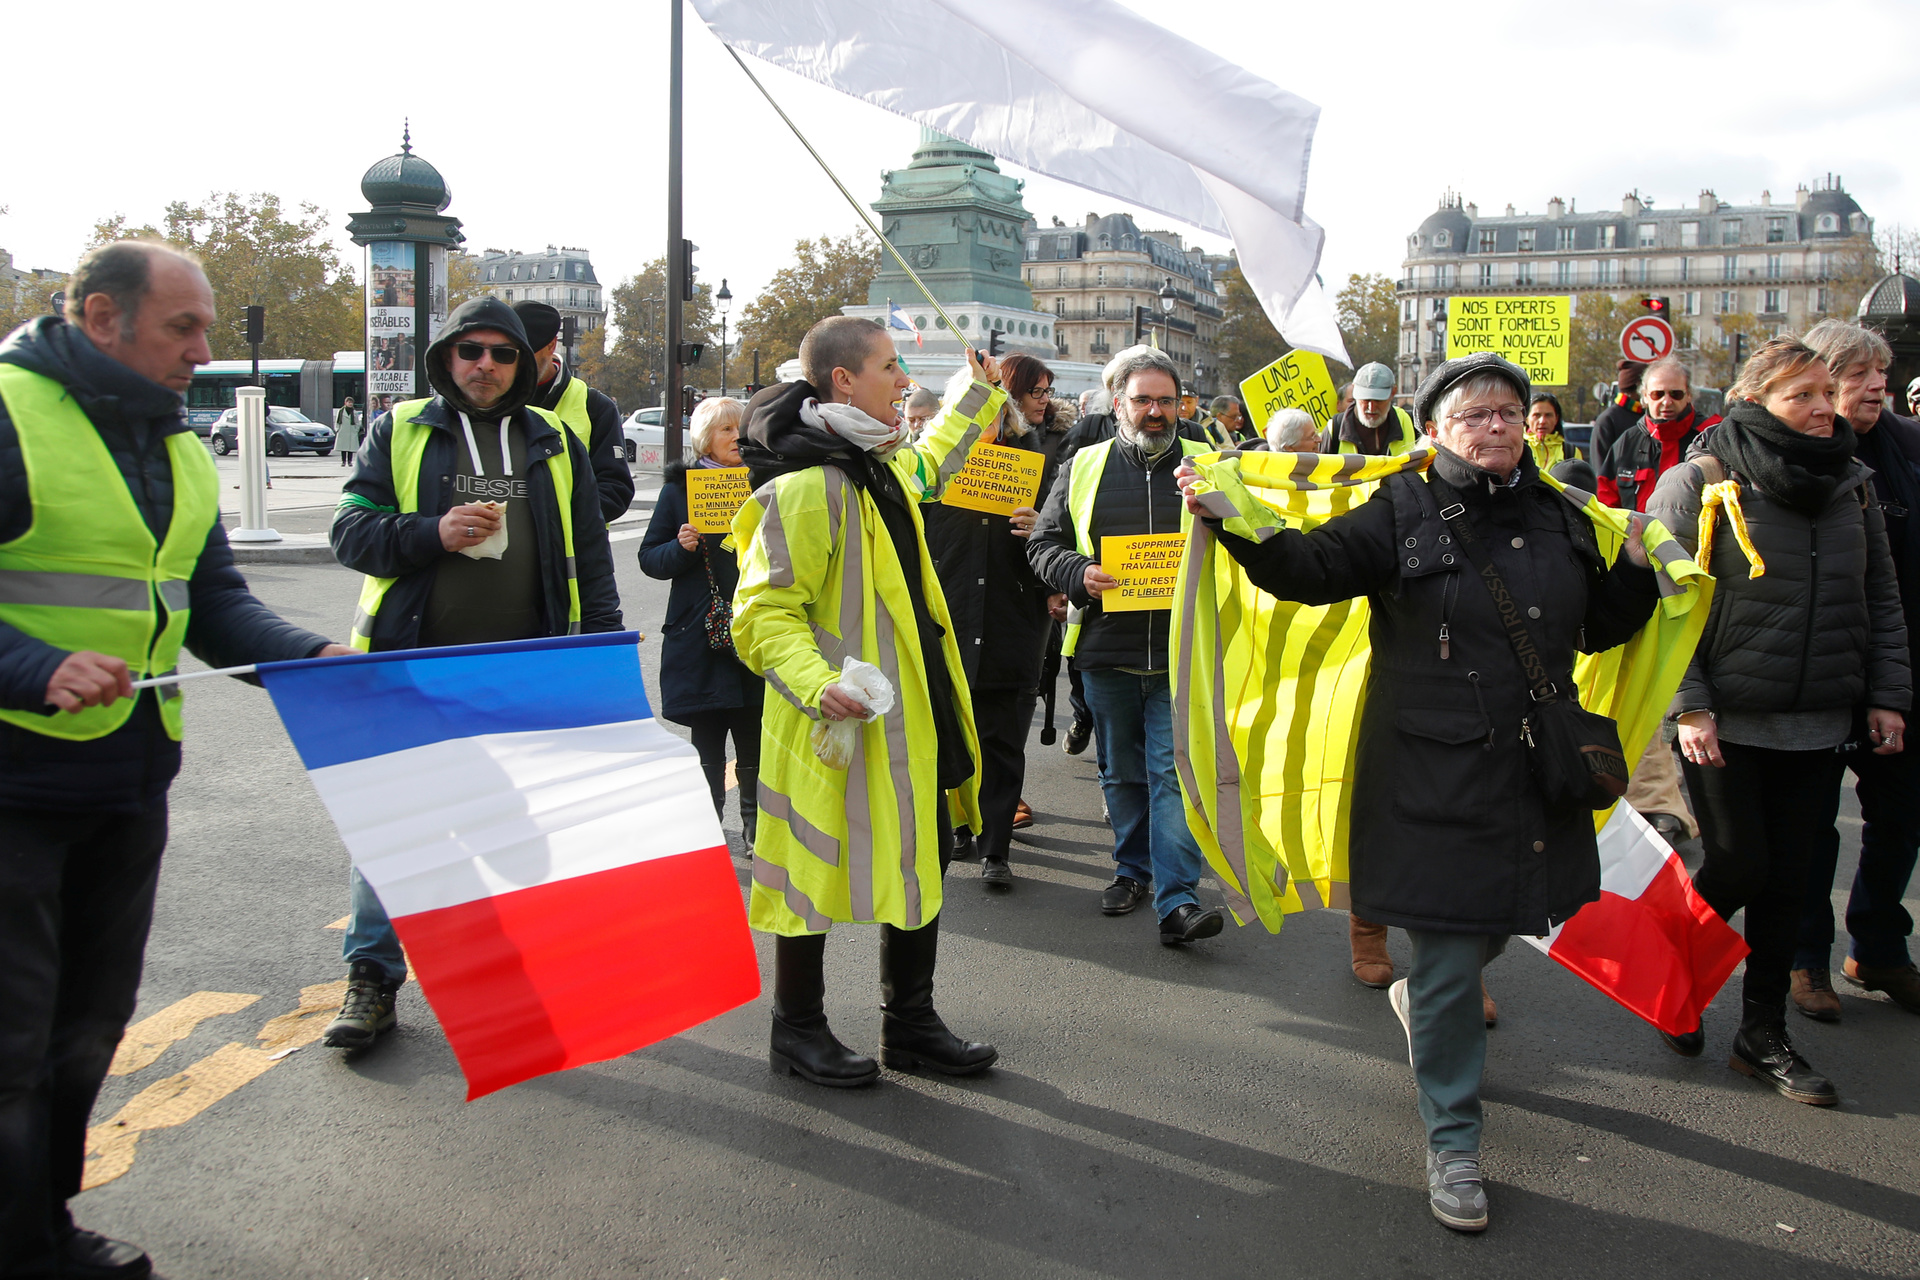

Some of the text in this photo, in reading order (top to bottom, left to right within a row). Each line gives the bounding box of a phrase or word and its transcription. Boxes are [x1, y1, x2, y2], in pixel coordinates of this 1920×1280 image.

[377, 308, 387, 317] LES
[1462, 301, 1556, 314] NOS EXPERTS
[1457, 317, 1561, 331] SONT FORMELS
[1452, 334, 1564, 348] VOTRE NOUVEAU
[1519, 351, 1547, 365] EST
[1262, 355, 1300, 393] UNIS
[1264, 377, 1315, 417] POUR LA
[977, 447, 1021, 462] LES PIRES
[961, 467, 1000, 481] N'EST-CE
[1002, 474, 1019, 484] PAS
[1020, 466, 1038, 477] VIES
[453, 474, 528, 498] IESE
[705, 482, 746, 490] FRANÇAIS
[953, 475, 1033, 498] GOUVERNANTS
[694, 492, 731, 500] DOIVENT
[961, 488, 979, 497] PAR
[980, 491, 1015, 504] INCURIE
[1129, 550, 1183, 560] LE PAIN DU
[1120, 560, 1181, 571] TRAVAILLEU
[1132, 577, 1148, 586] LUI
[1150, 576, 1177, 585] REST
[1121, 588, 1135, 597] DE
